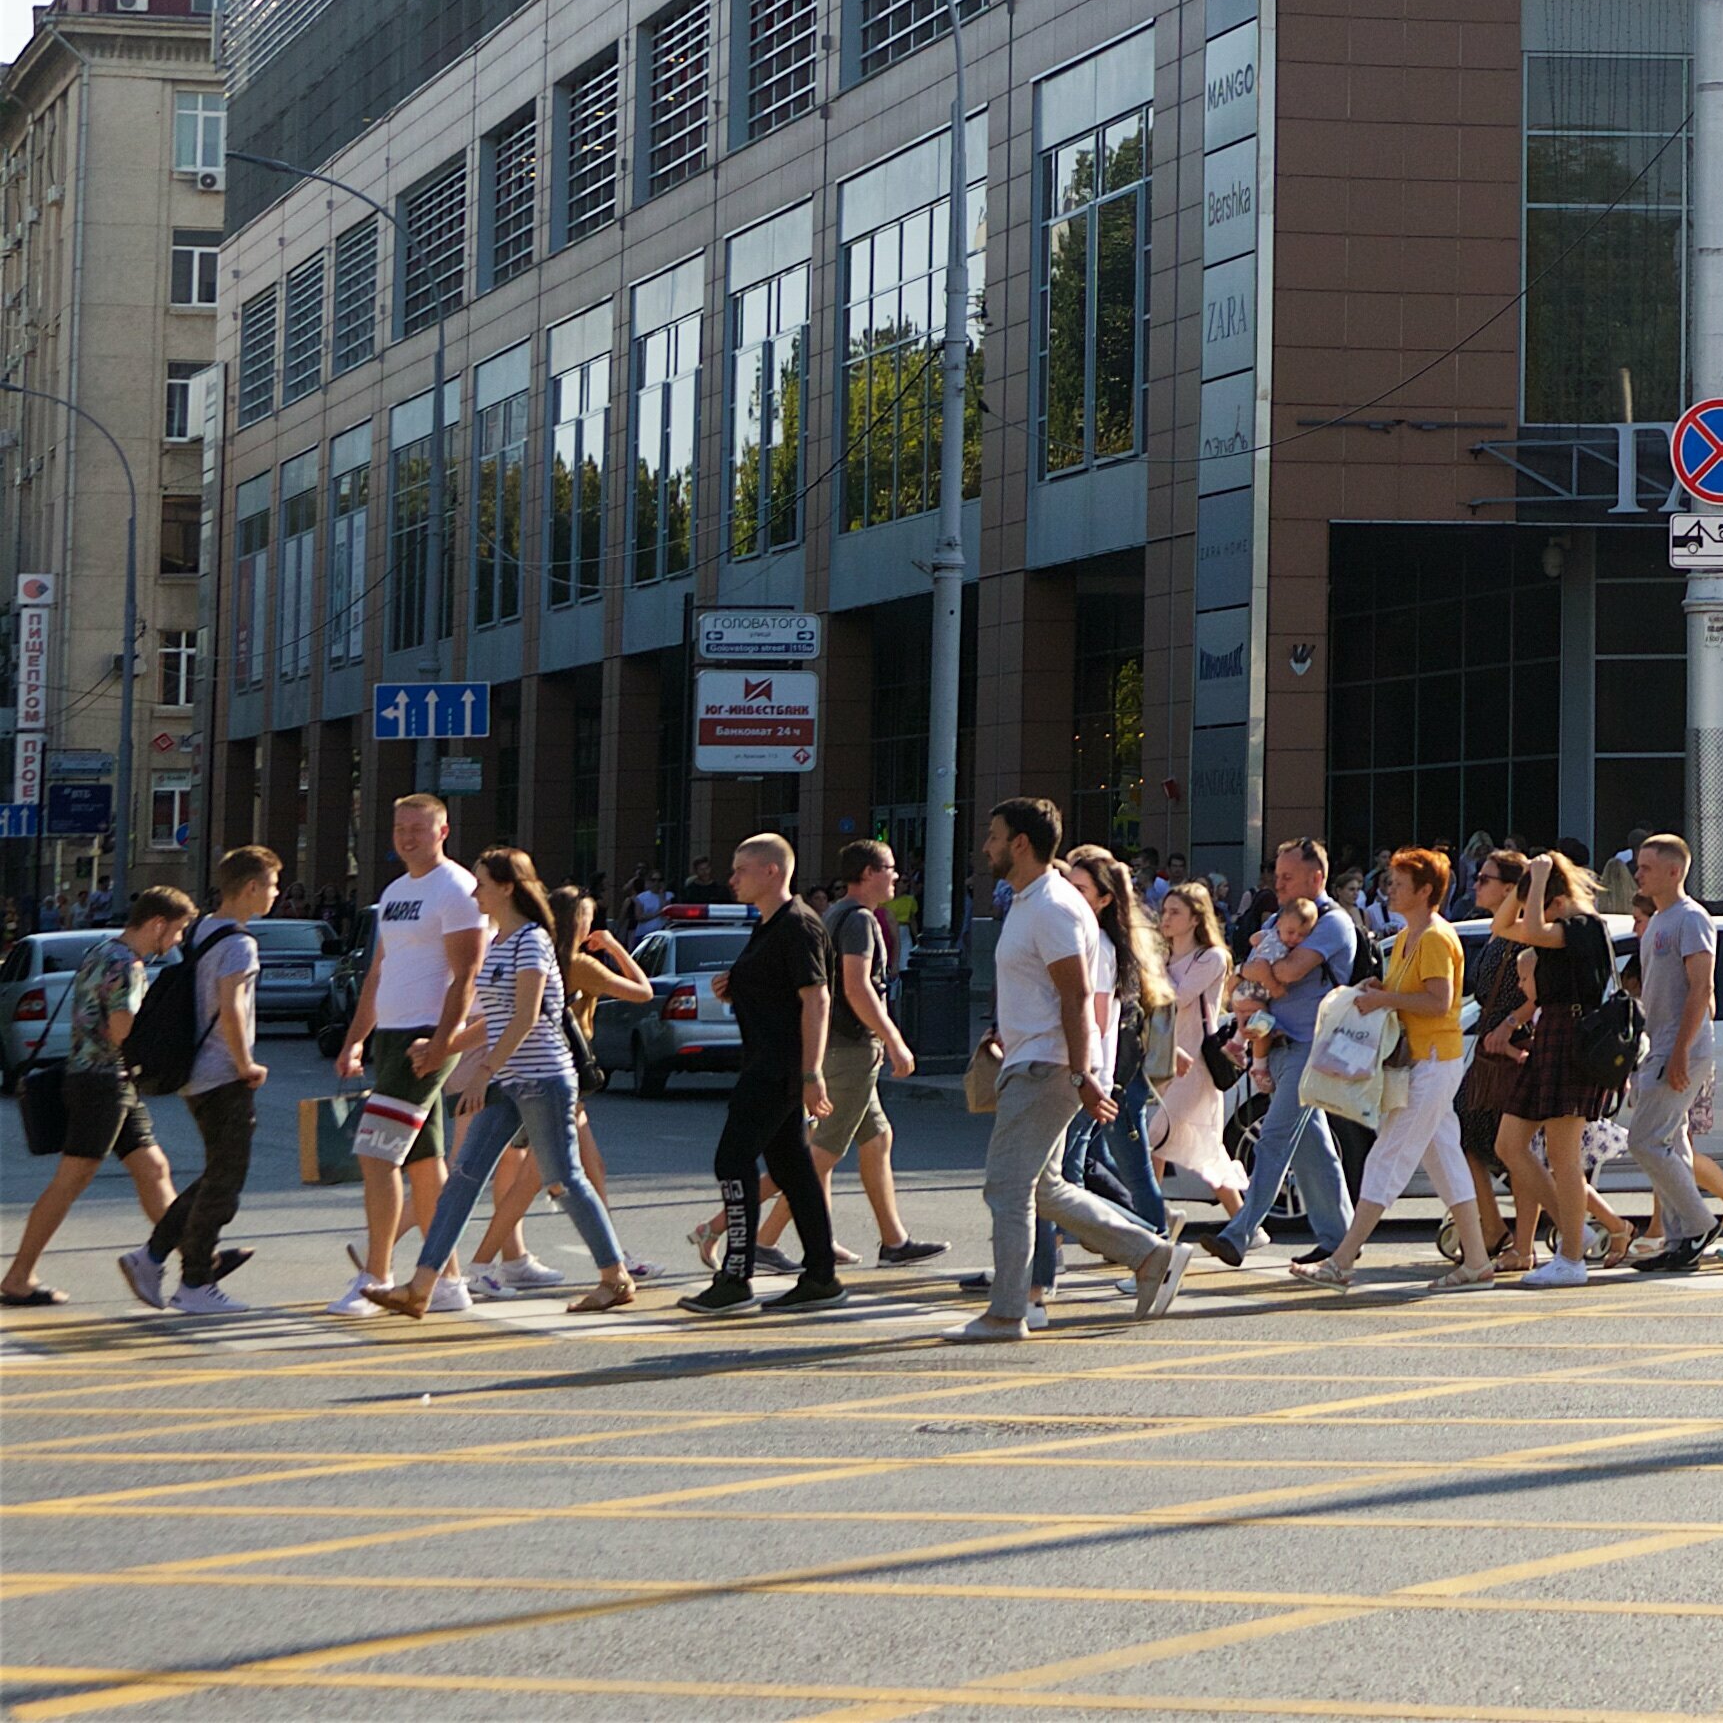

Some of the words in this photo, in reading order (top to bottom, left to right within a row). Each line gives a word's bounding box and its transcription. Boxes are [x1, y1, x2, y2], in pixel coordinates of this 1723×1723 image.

[1207, 63, 1255, 112] MANGO
[1208, 180, 1251, 227] Bershka
[1206, 293, 1248, 343] ZARA
[713, 617, 808, 629] ГОЛОВАТОГО
[25, 613, 43, 723] ПИЩЕПРОМ
[715, 726, 772, 737] Банкомат
[776, 727, 790, 736] 24
[22, 739, 38, 804] ПРОЕ
[382, 899, 424, 922] MARVEL
[726, 1204, 747, 1248] HIGH
